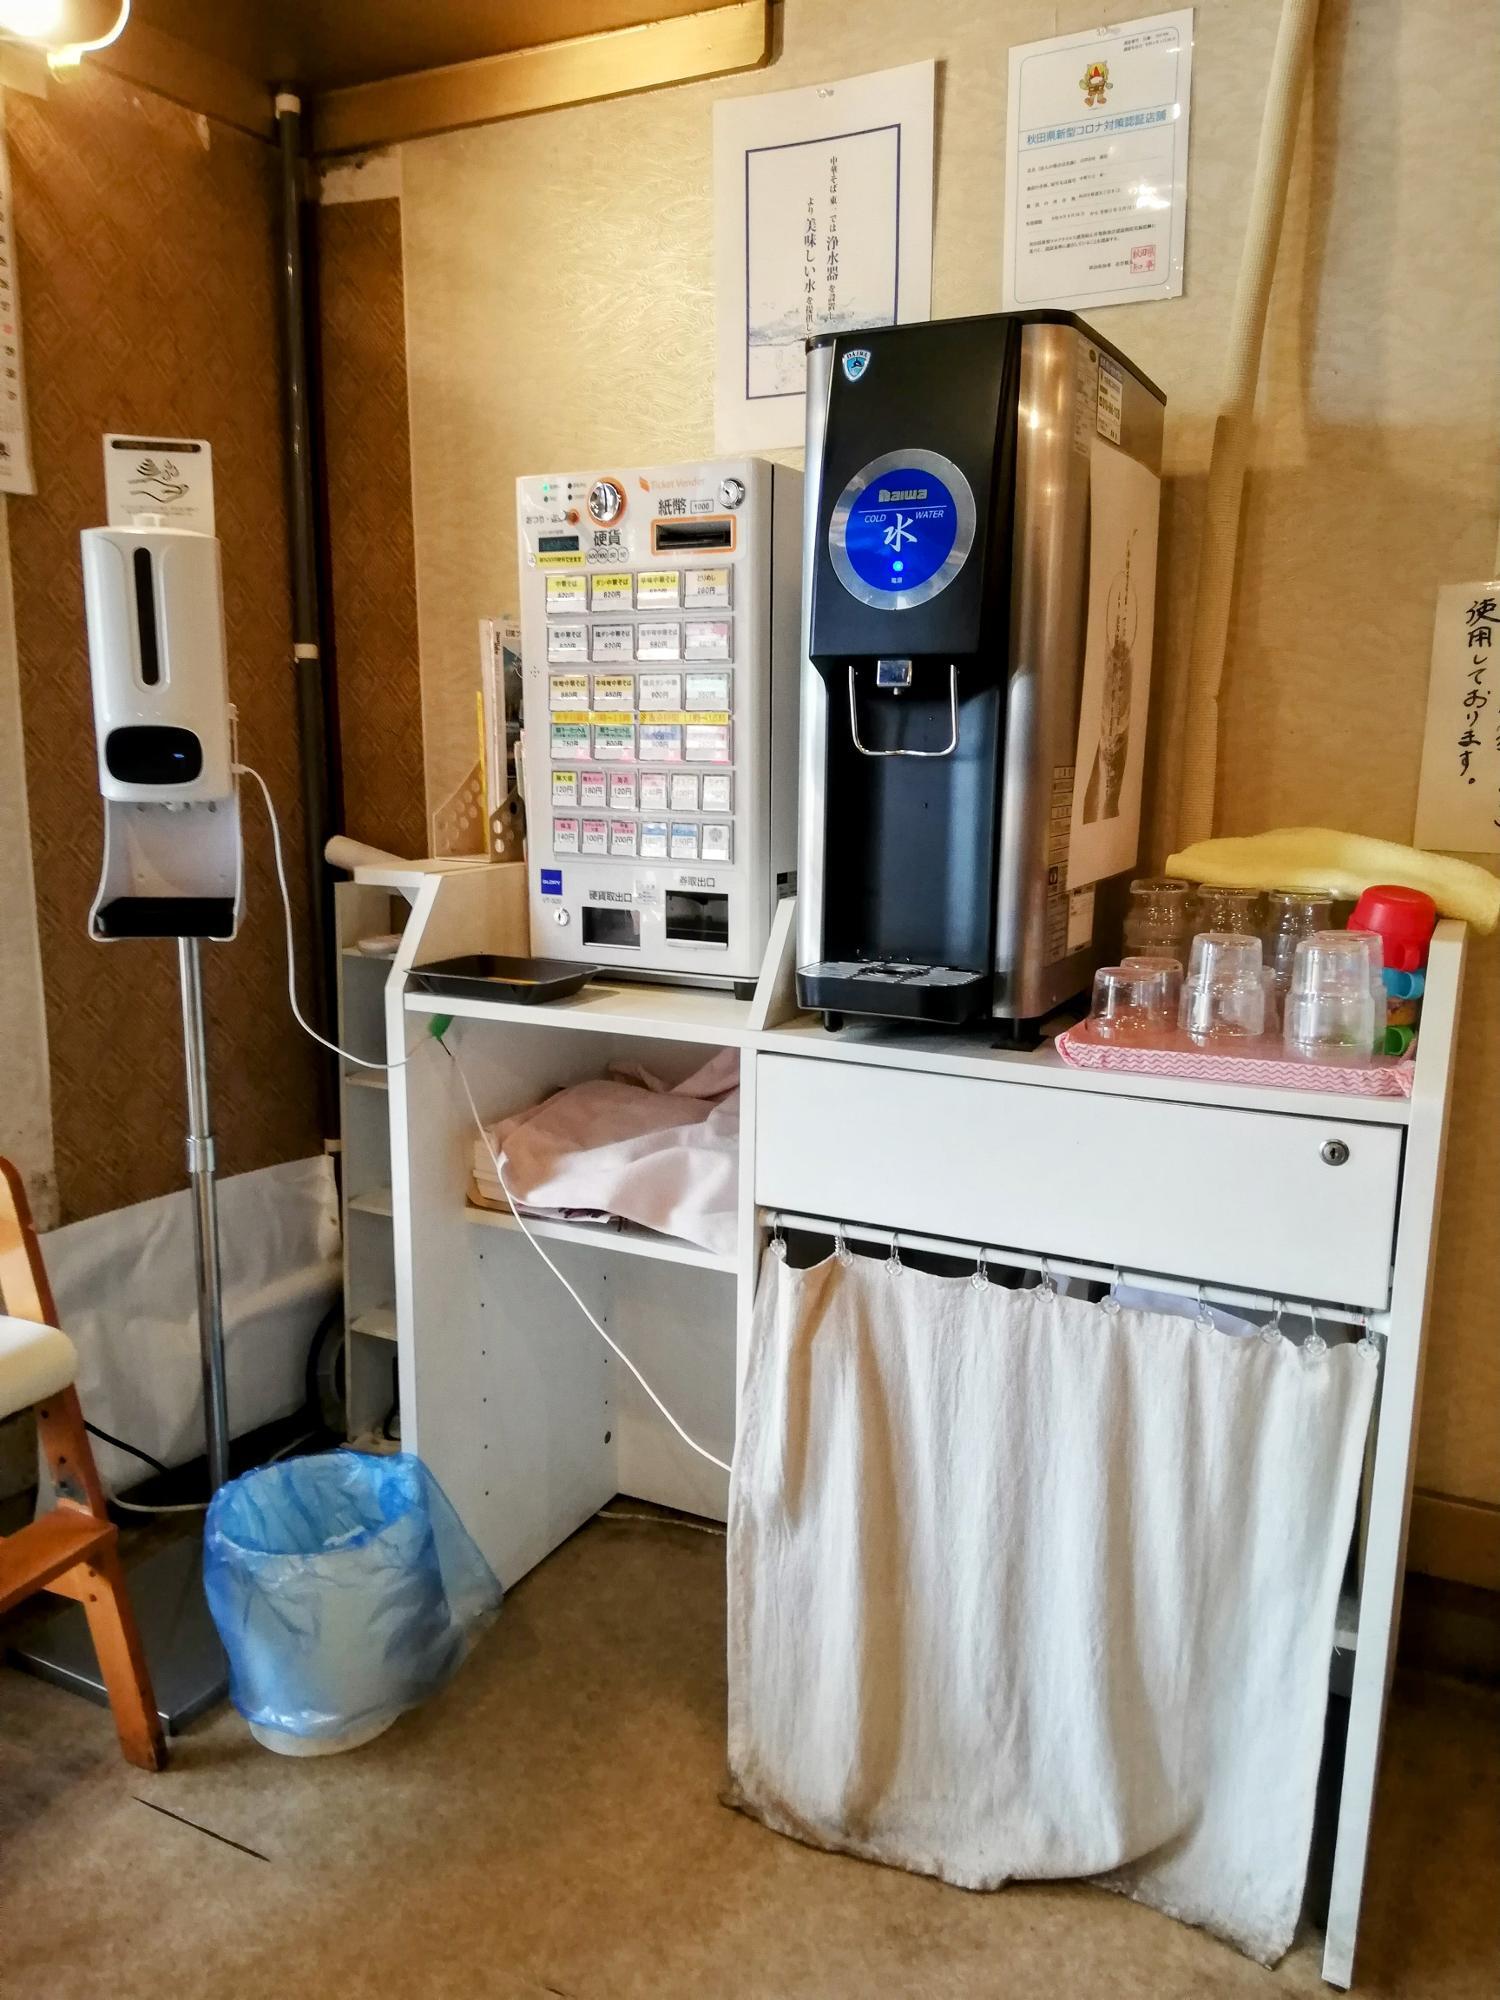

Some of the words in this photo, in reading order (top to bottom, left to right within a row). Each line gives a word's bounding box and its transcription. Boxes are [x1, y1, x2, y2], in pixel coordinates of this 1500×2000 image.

[658, 497, 687, 516] 紙幣
[694, 502, 710, 511] 1000
[864, 514, 887, 523] COLD
[915, 510, 944, 519] WATER
[593, 530, 622, 546] 硬貨
[883, 513, 918, 553] 水
[1458, 597, 1500, 785] 使用しております。
[679, 876, 716, 888] 券取出口
[589, 890, 632, 903] 硬貨取出口
